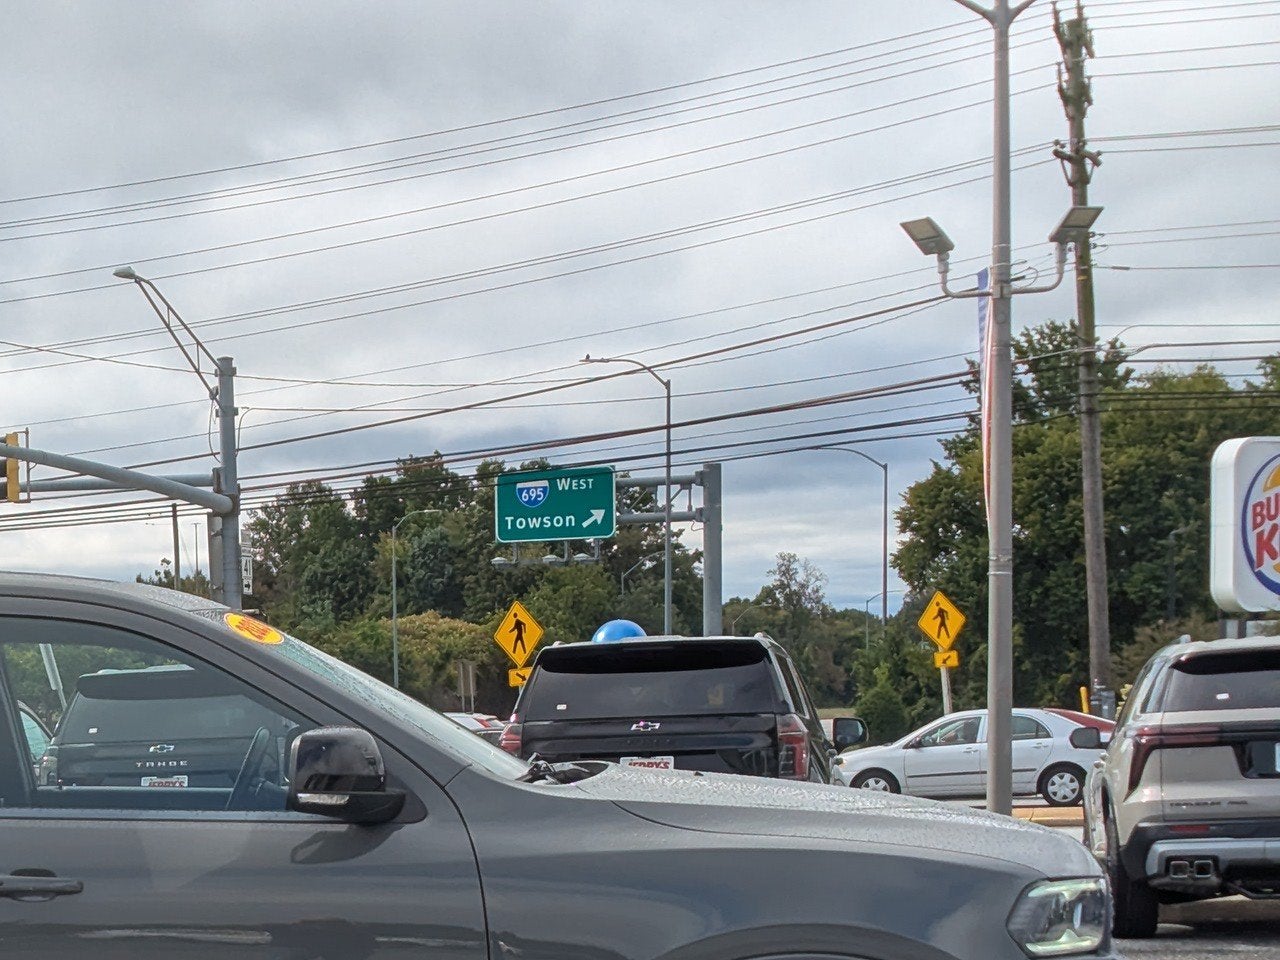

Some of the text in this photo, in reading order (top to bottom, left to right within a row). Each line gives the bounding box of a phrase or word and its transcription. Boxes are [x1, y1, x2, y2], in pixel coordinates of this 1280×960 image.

[522, 487, 544, 502] 695
[505, 514, 575, 530] Towson
[1254, 522, 1280, 573] K
[136, 760, 188, 768] TAHOE
